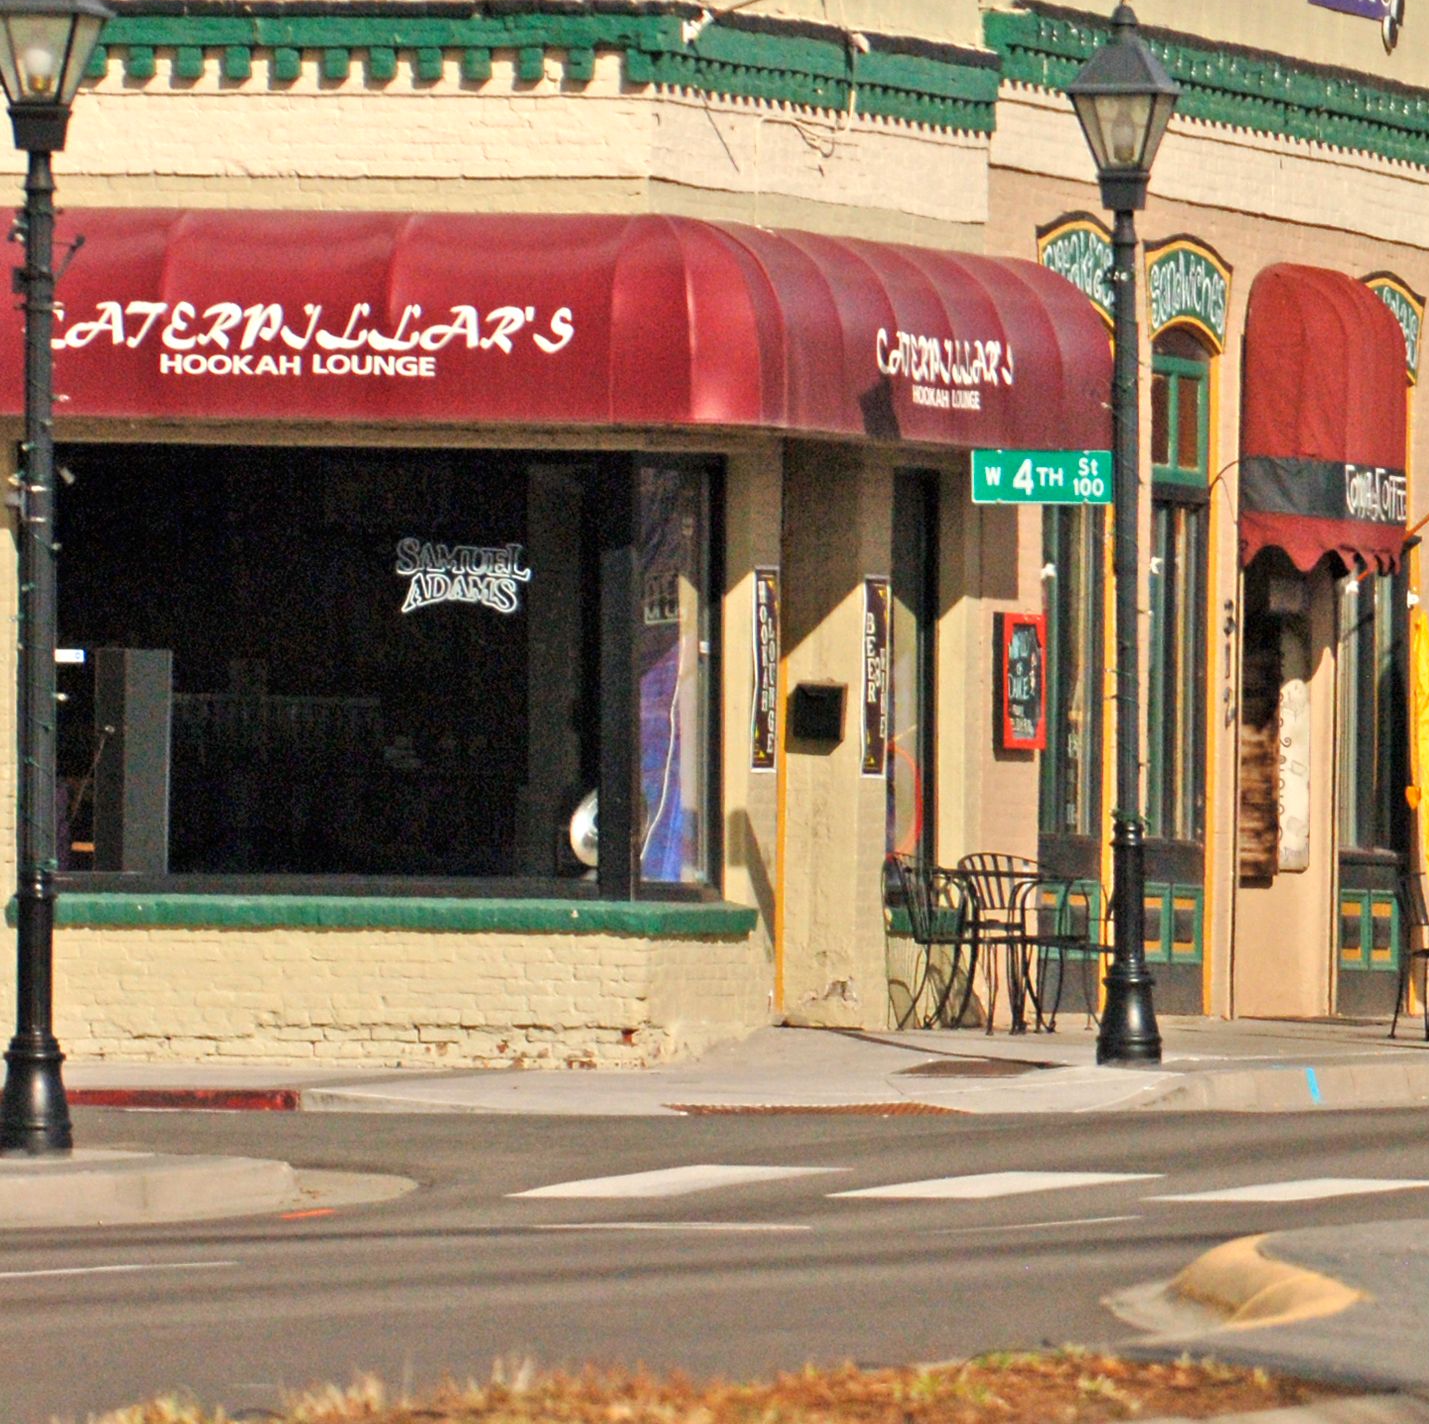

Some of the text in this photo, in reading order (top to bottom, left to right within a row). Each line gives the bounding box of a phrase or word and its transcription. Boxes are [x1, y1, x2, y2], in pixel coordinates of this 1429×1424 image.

[159, 353, 437, 377] HOOKAH LOUNGE
[912, 384, 982, 411] HOOKAH LOUNGE
[984, 457, 1099, 496] W 4TH St
[1073, 477, 1105, 497] 100
[396, 537, 533, 582] SAMUEL
[401, 572, 518, 614] ADAMS
[866, 611, 877, 704] BEER
